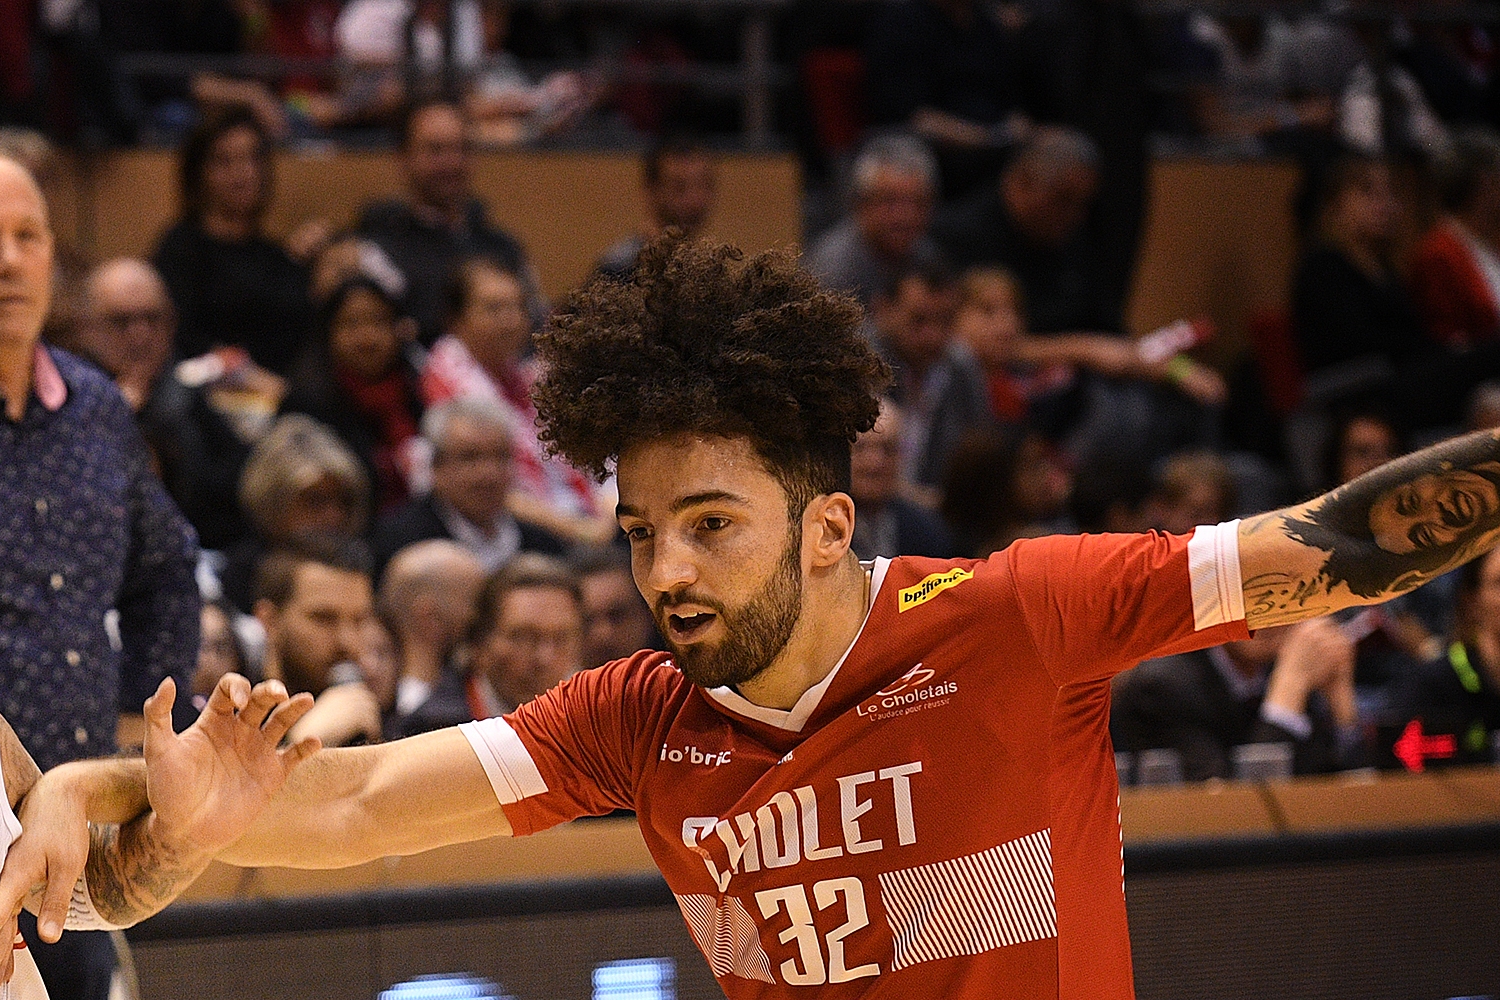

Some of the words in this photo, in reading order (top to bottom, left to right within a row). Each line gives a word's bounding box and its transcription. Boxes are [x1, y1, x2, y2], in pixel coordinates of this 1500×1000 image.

[856, 704, 879, 717] Le
[881, 681, 958, 709] Choletais
[905, 704, 922, 716] pour
[682, 761, 923, 893] CHOLET
[754, 876, 881, 986] 32
